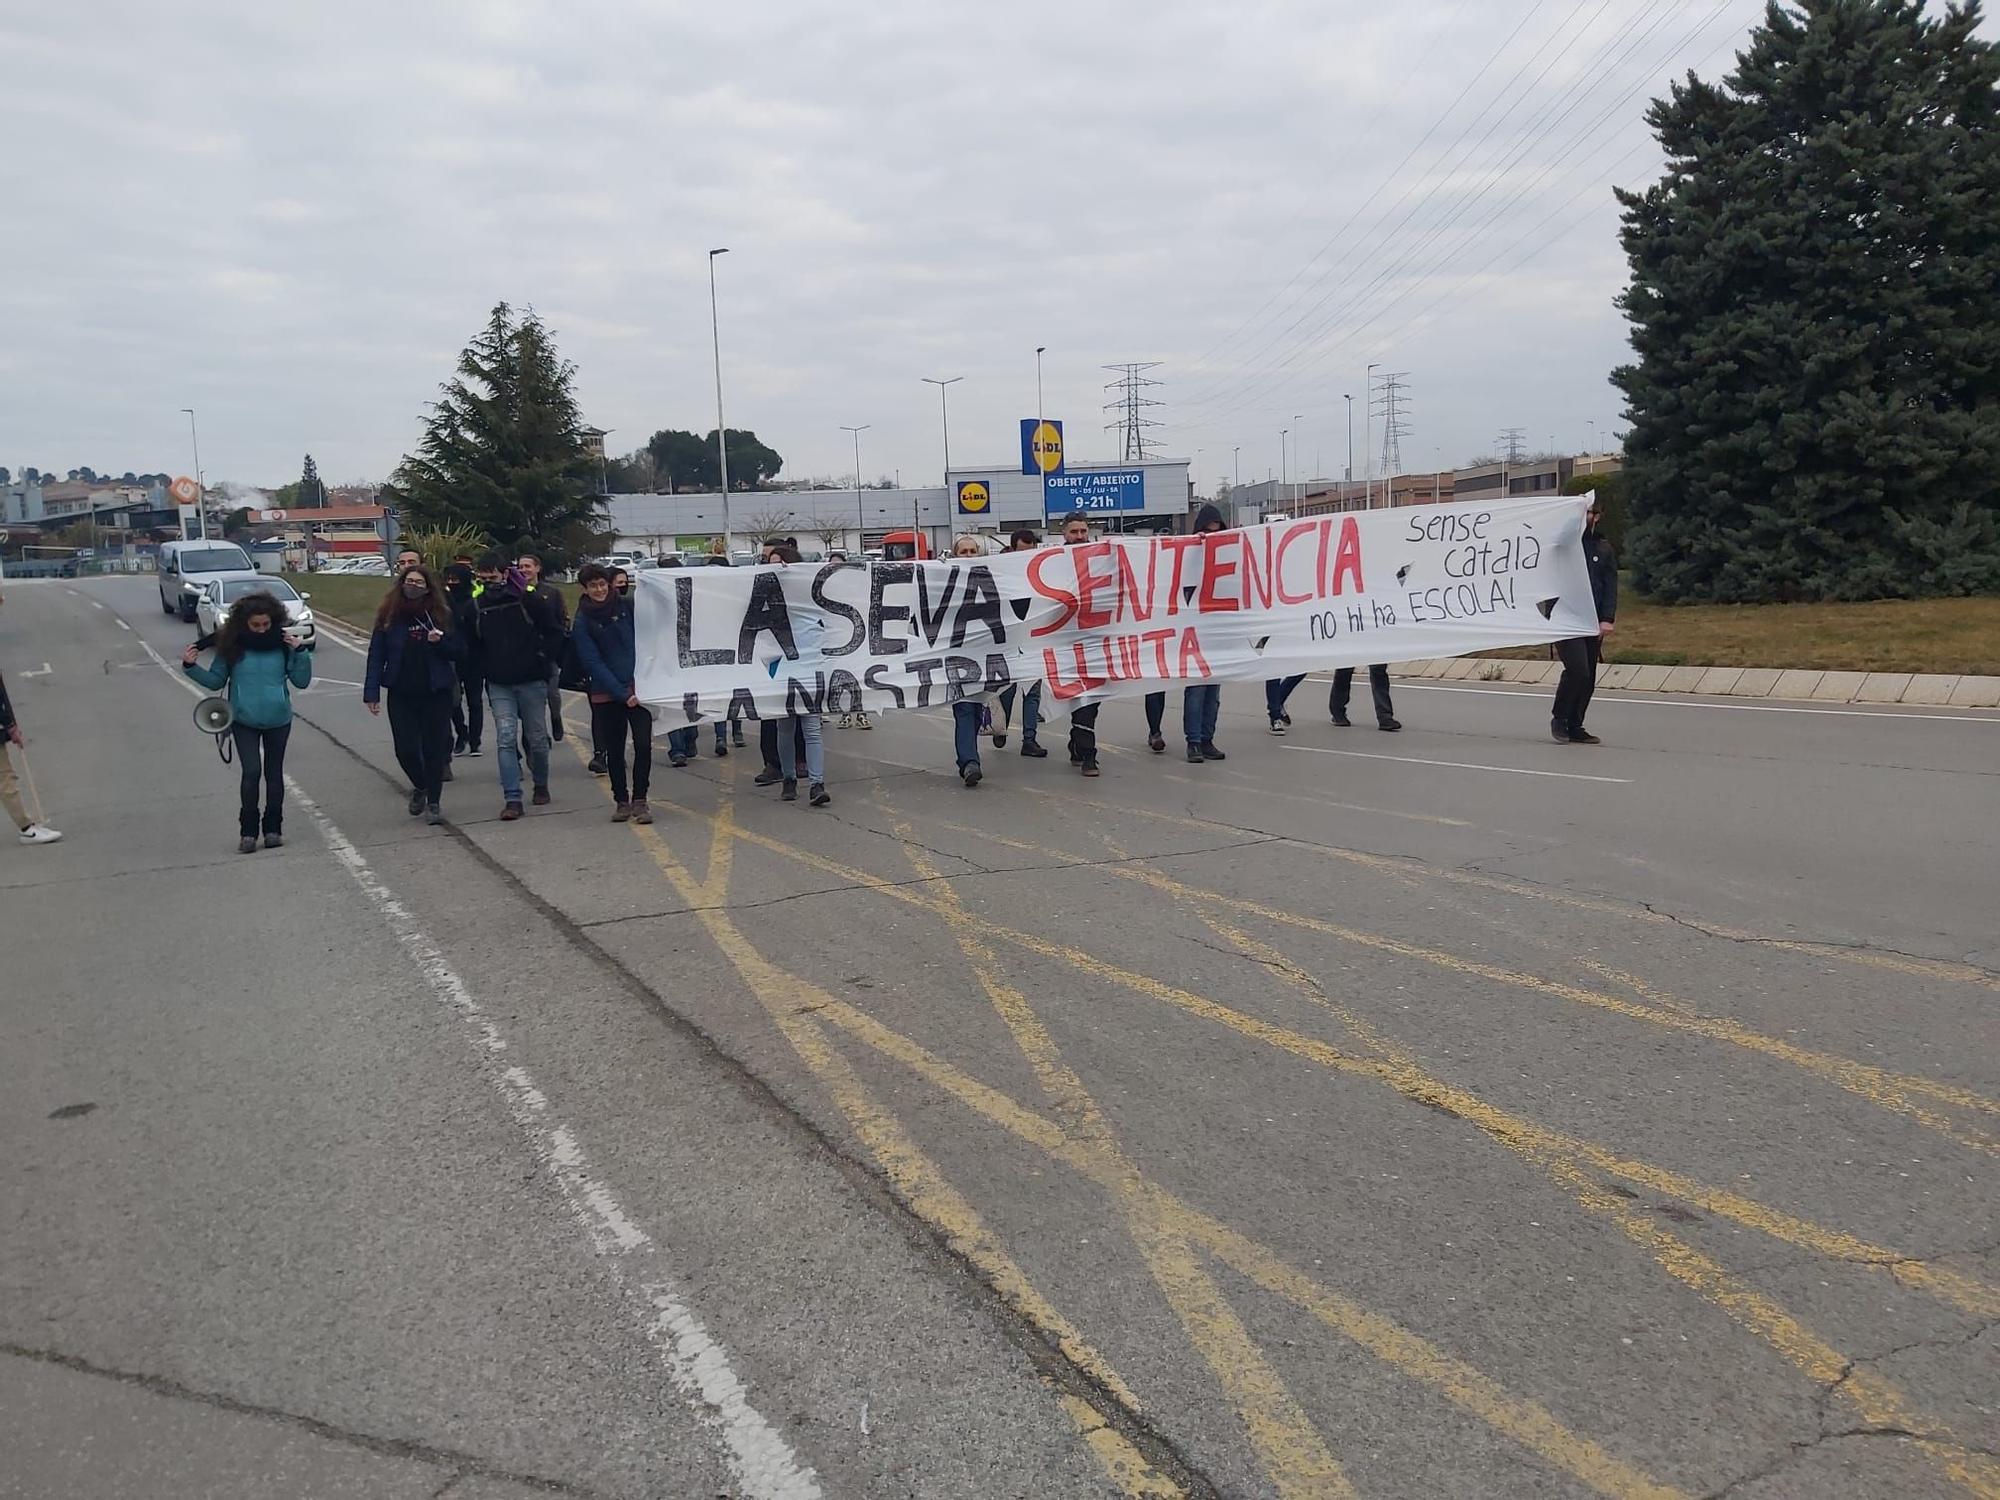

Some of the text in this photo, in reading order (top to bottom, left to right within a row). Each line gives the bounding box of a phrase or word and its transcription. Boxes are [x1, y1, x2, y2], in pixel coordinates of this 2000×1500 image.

[1048, 474, 1140, 488] OBERT / ABIERTO
[1075, 495, 1114, 508] 9-21h
[1405, 512, 1491, 542] sense
[1444, 523, 1540, 578] català
[675, 516, 1365, 669] LA SEVA SENTENCIA
[1310, 577, 1516, 641] no hi ha ESCOLA!
[786, 653, 1011, 717] NOSTRA
[1043, 626, 1212, 700] LLUITA
